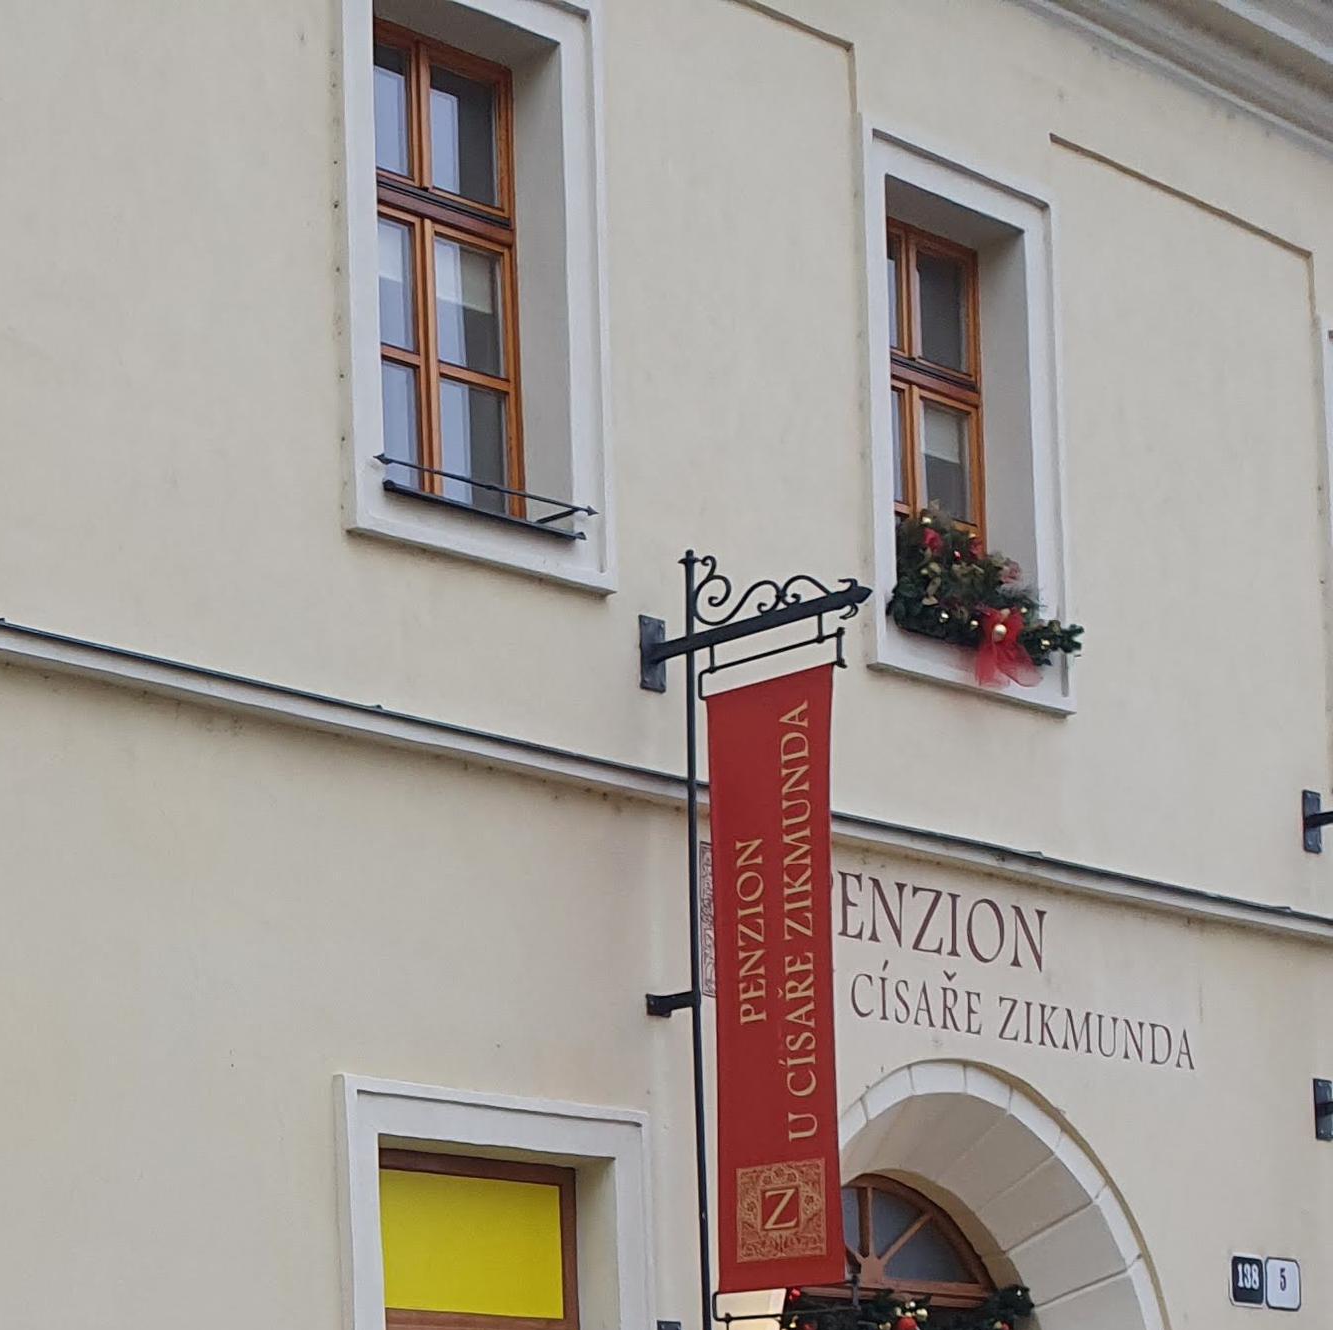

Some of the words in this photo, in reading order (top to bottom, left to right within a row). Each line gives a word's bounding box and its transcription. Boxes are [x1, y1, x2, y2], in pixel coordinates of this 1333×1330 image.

[779, 700, 813, 941] ZIKMUNDA
[735, 838, 767, 1026] PENZION
[836, 869, 1047, 973] ENZION
[777, 952, 817, 1097] CÍSAŘE
[850, 960, 983, 1036] CÍSAŘE
[997, 996, 1196, 1071] ZIKMUNDA
[788, 1112, 818, 1142] U
[763, 1187, 798, 1231] Z
[1279, 1267, 1287, 1292] 5
